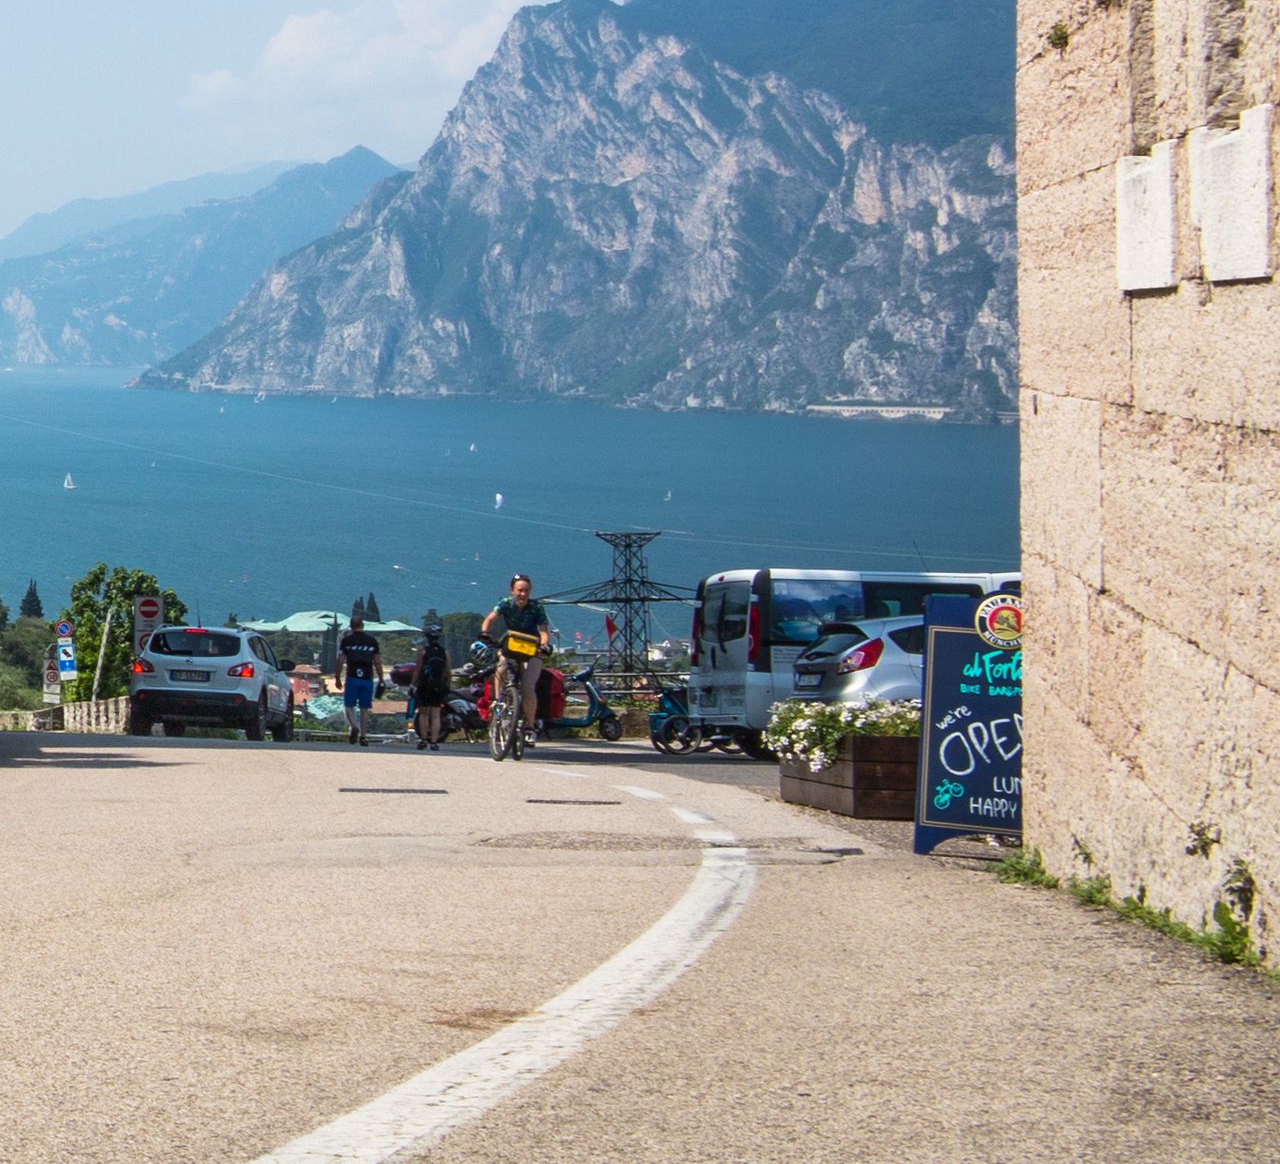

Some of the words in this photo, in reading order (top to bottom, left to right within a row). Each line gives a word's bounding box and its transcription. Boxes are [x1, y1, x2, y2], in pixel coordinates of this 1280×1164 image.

[960, 683, 981, 695] BIKE
[936, 705, 972, 730] we're
[969, 797, 1018, 819] HAPPY
